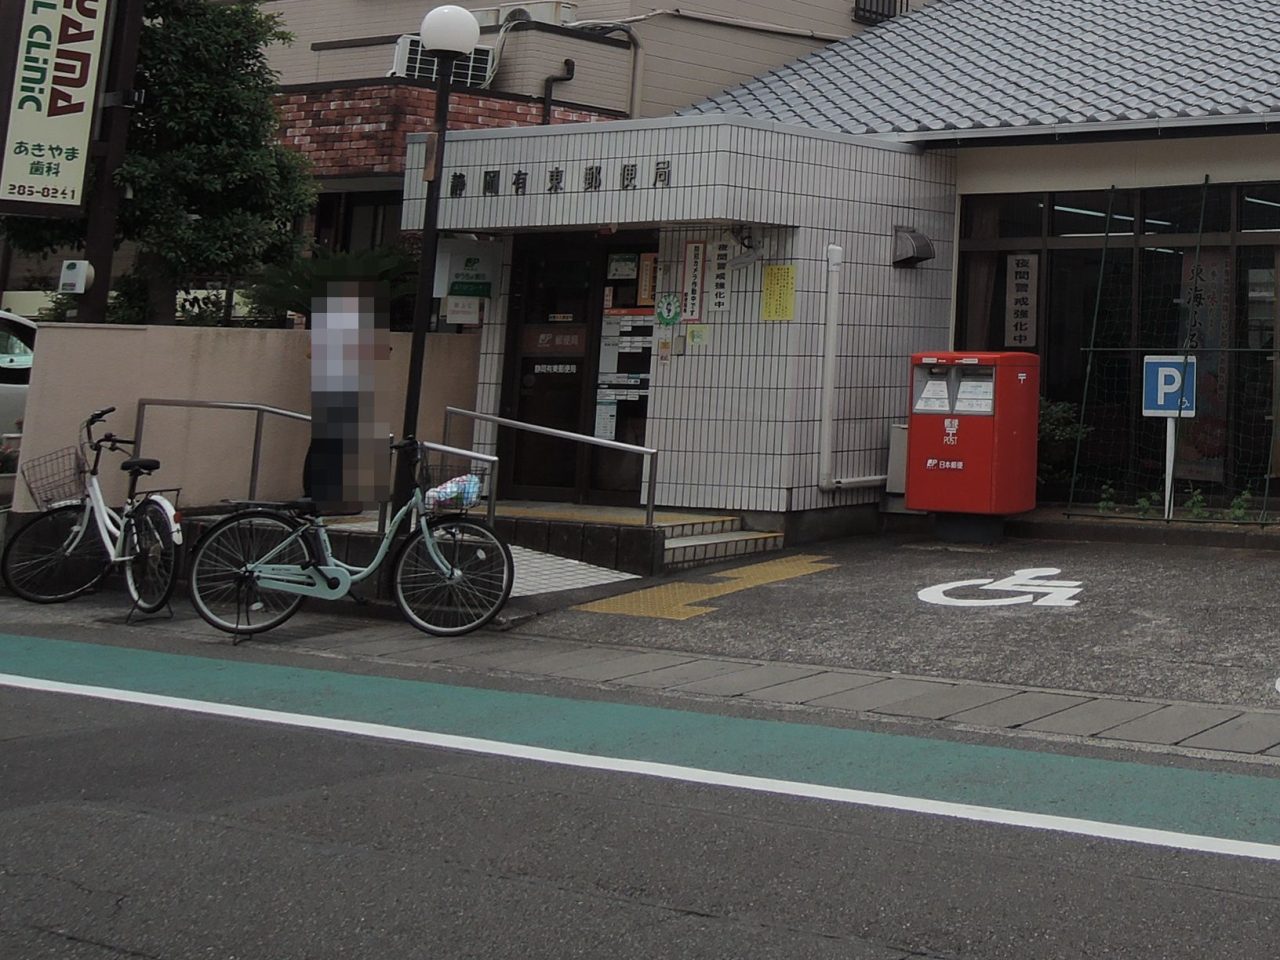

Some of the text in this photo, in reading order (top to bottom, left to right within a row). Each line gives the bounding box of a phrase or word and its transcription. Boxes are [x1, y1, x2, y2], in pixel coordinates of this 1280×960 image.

[13, 141, 80, 161] あきやま
[29, 160, 61, 177] 歯科
[450, 160, 671, 198] 静岡有東郵便局
[8, 183, 76, 200] 285-8241
[714, 243, 729, 308] 夜間警戒強化中
[1013, 257, 1031, 345] 夜間警戒強化中
[1184, 263, 1207, 355] 東海ふる
[1158, 368, 1182, 405] P
[943, 436, 958, 445] POST
[939, 460, 964, 470] 日本郵便
